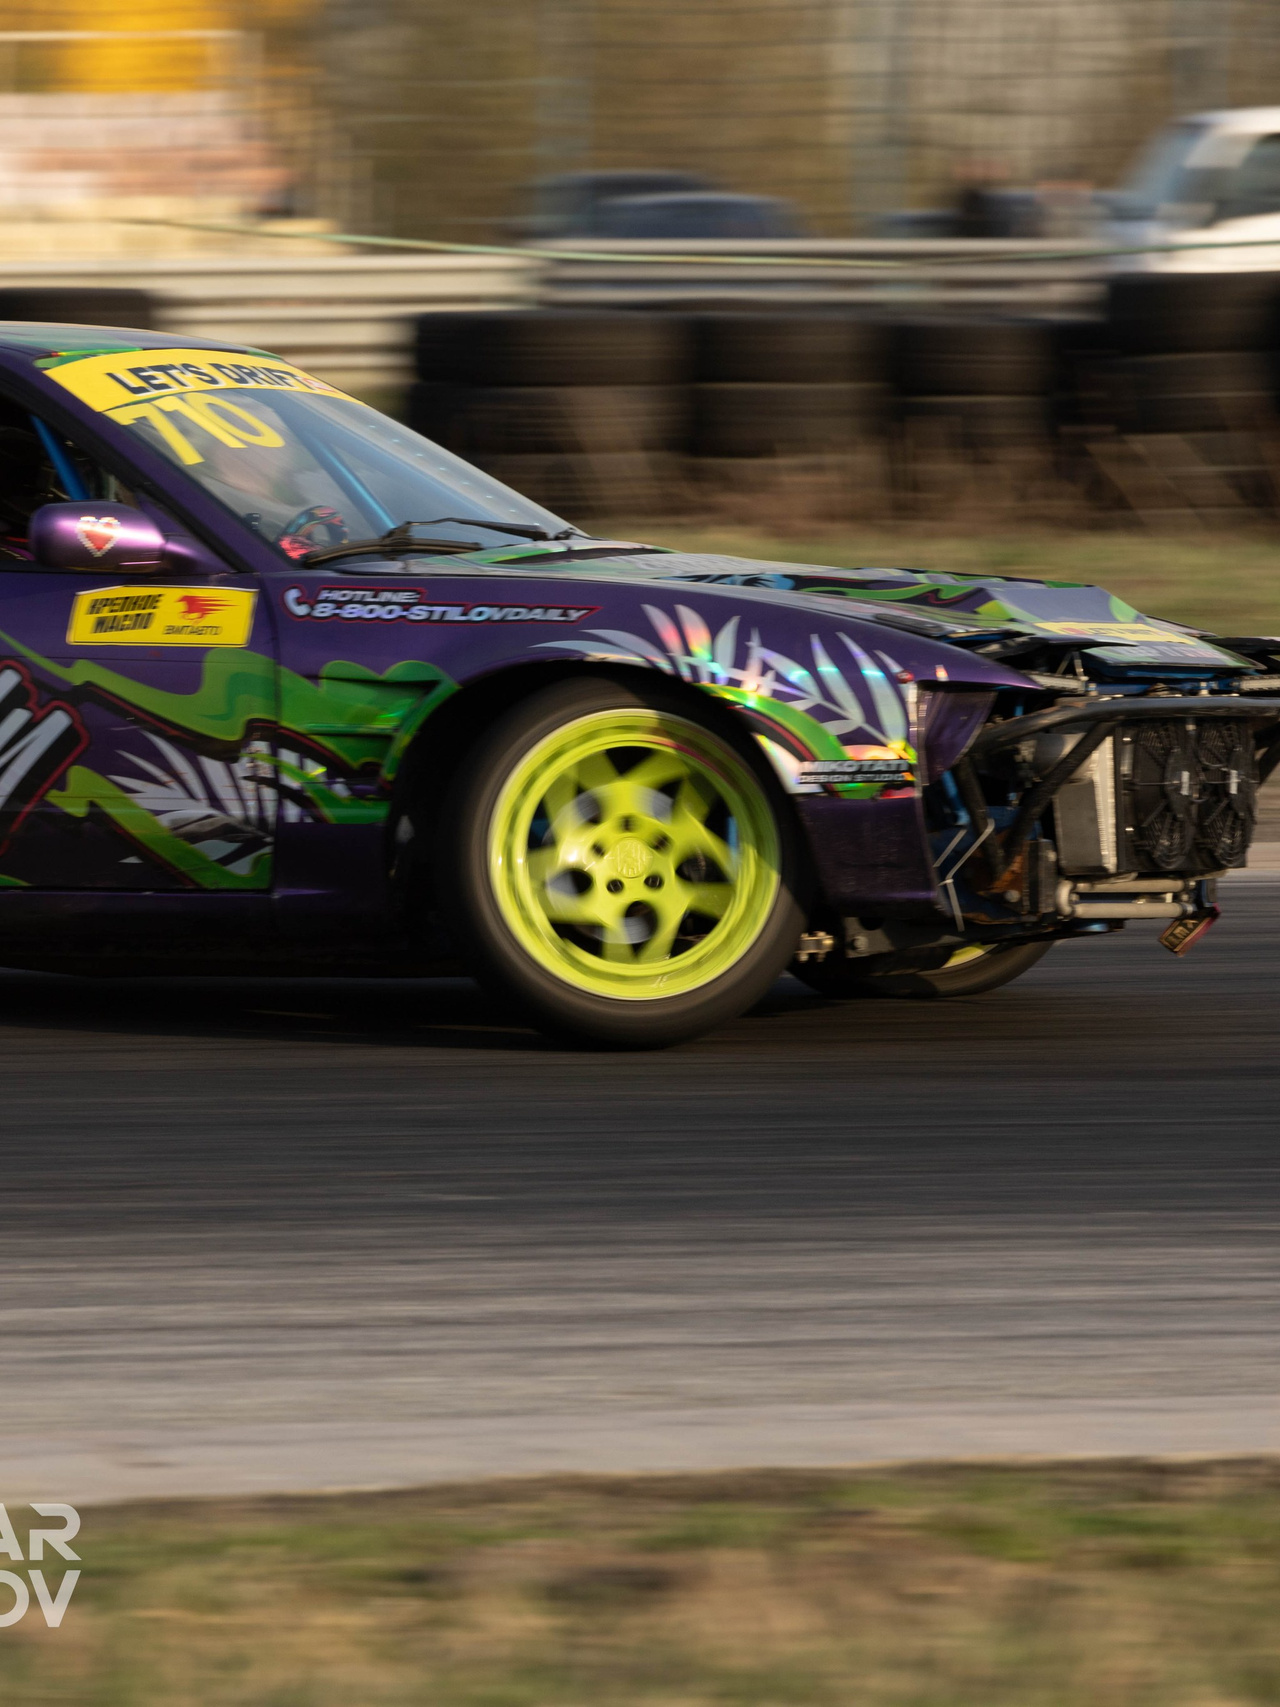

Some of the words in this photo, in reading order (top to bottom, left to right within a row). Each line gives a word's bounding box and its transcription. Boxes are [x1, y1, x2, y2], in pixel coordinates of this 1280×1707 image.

[105, 363, 225, 396] LET'S
[102, 392, 286, 466] 710
[320, 589, 420, 602] HOTLINE:
[311, 603, 589, 621] 8-800-STILOVDAILY
